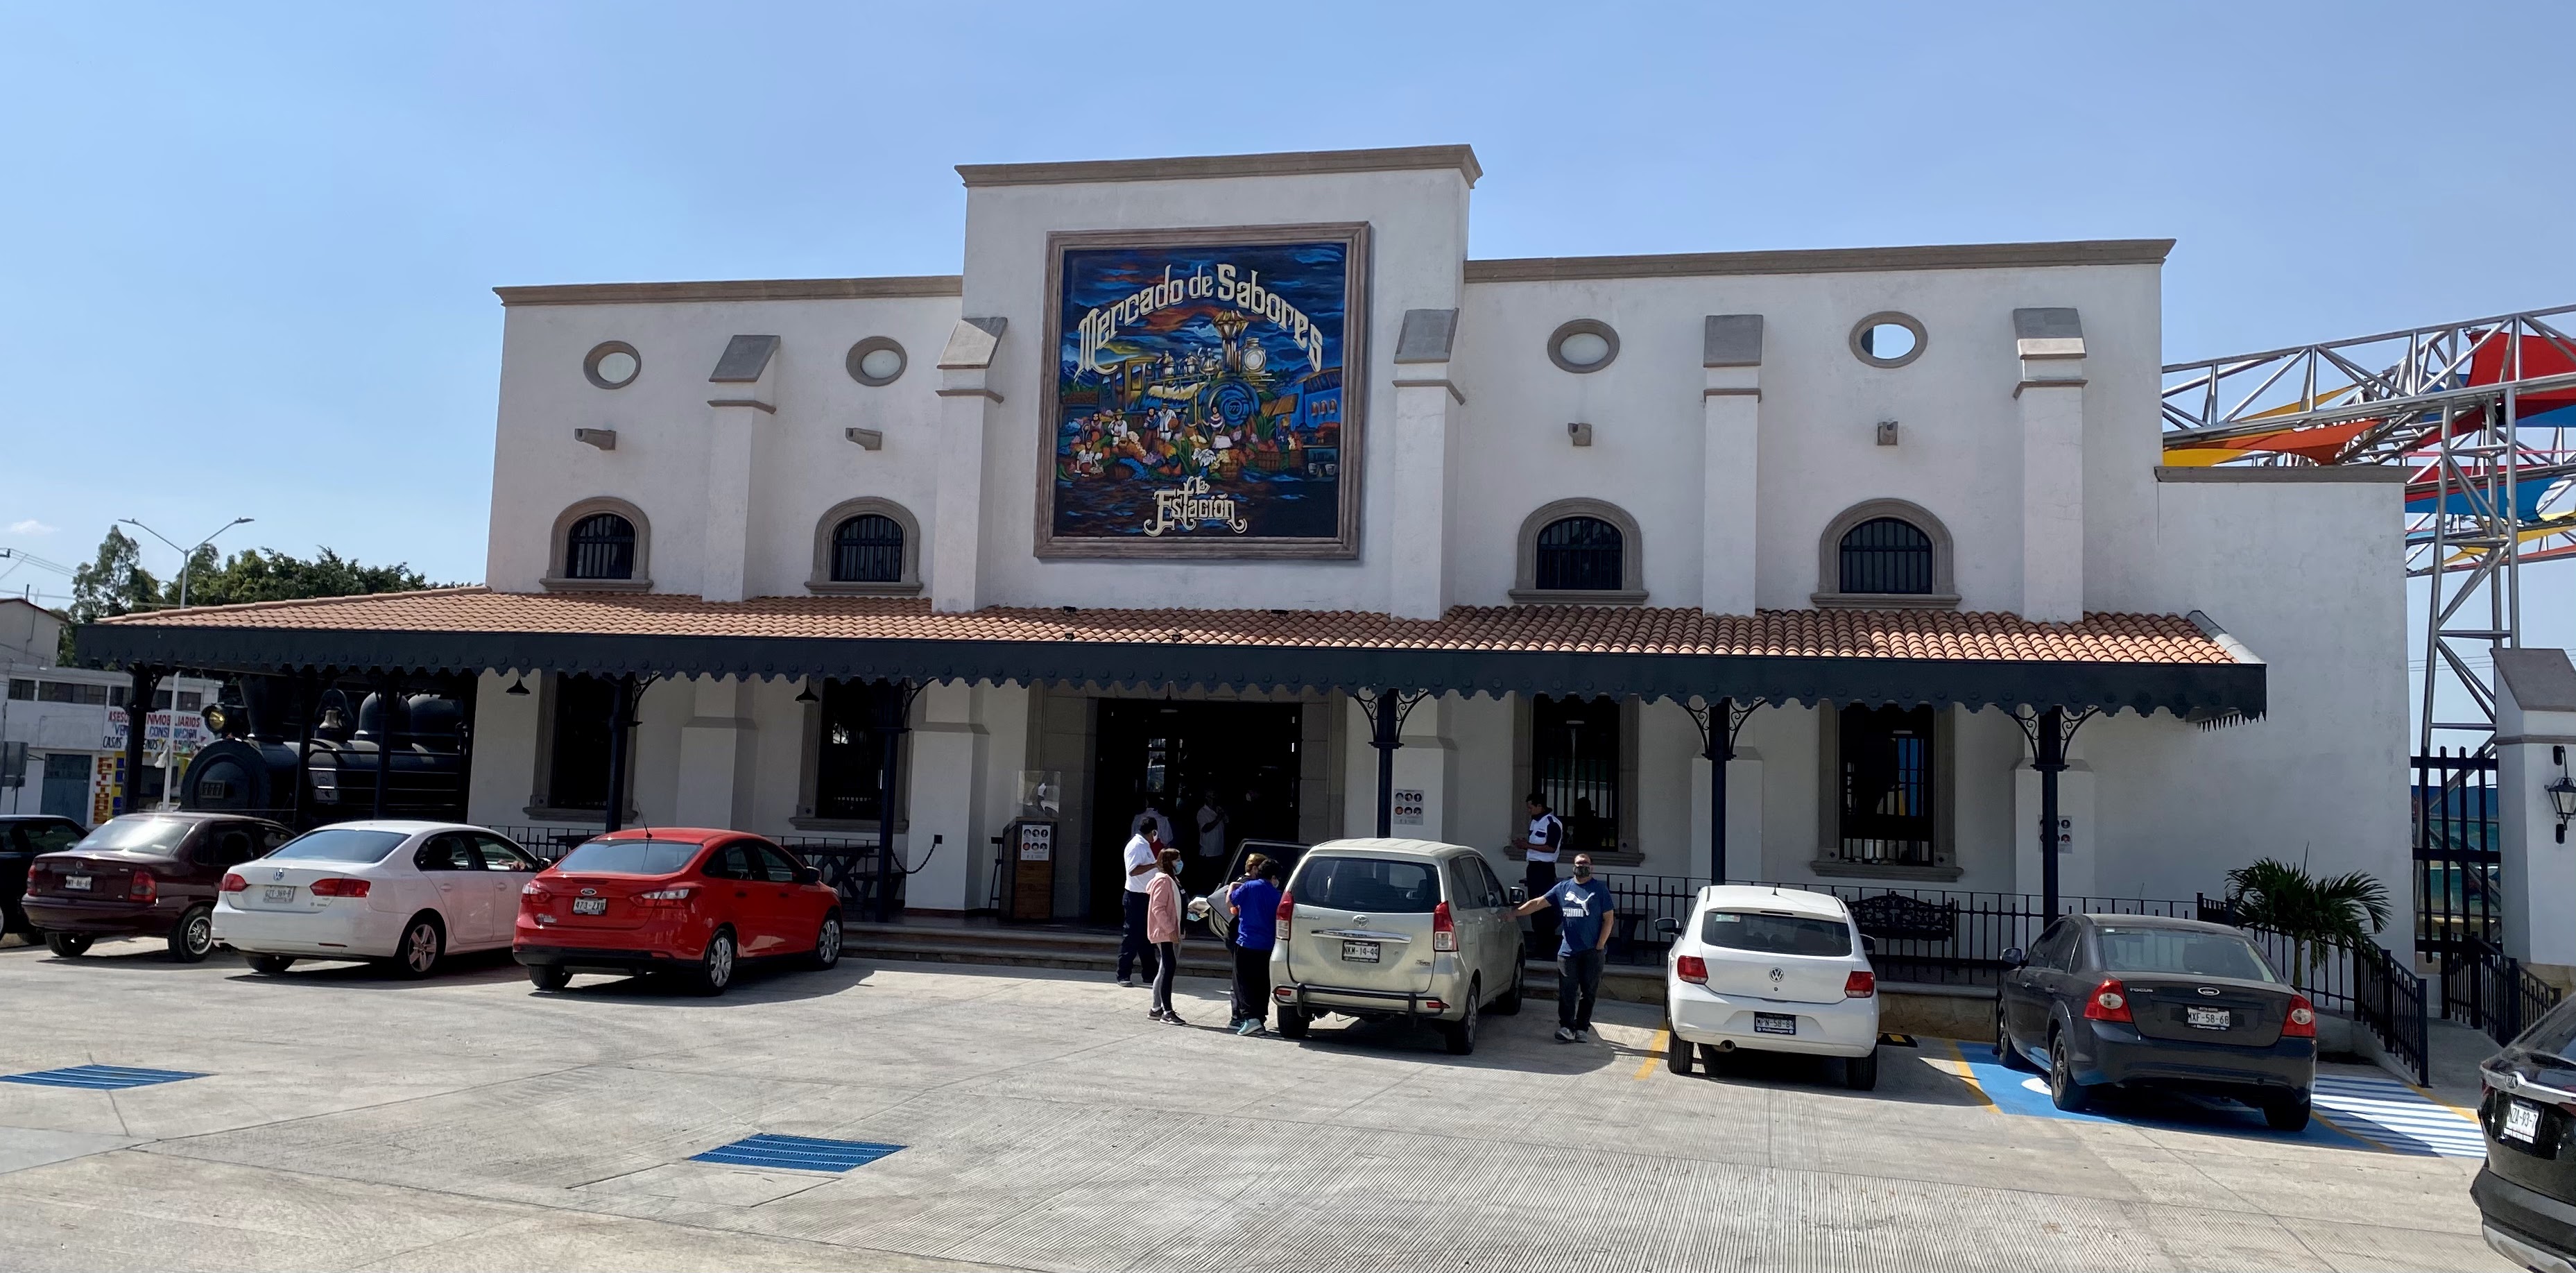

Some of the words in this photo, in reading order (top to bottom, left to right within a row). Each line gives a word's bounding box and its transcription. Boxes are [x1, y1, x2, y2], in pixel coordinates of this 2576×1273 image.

[1074, 264, 1184, 382] Mercado
[1188, 264, 1214, 298] de
[1217, 264, 1323, 373] Sabores
[1143, 476, 1248, 537] Estación
[103, 735, 122, 749] CASAS
